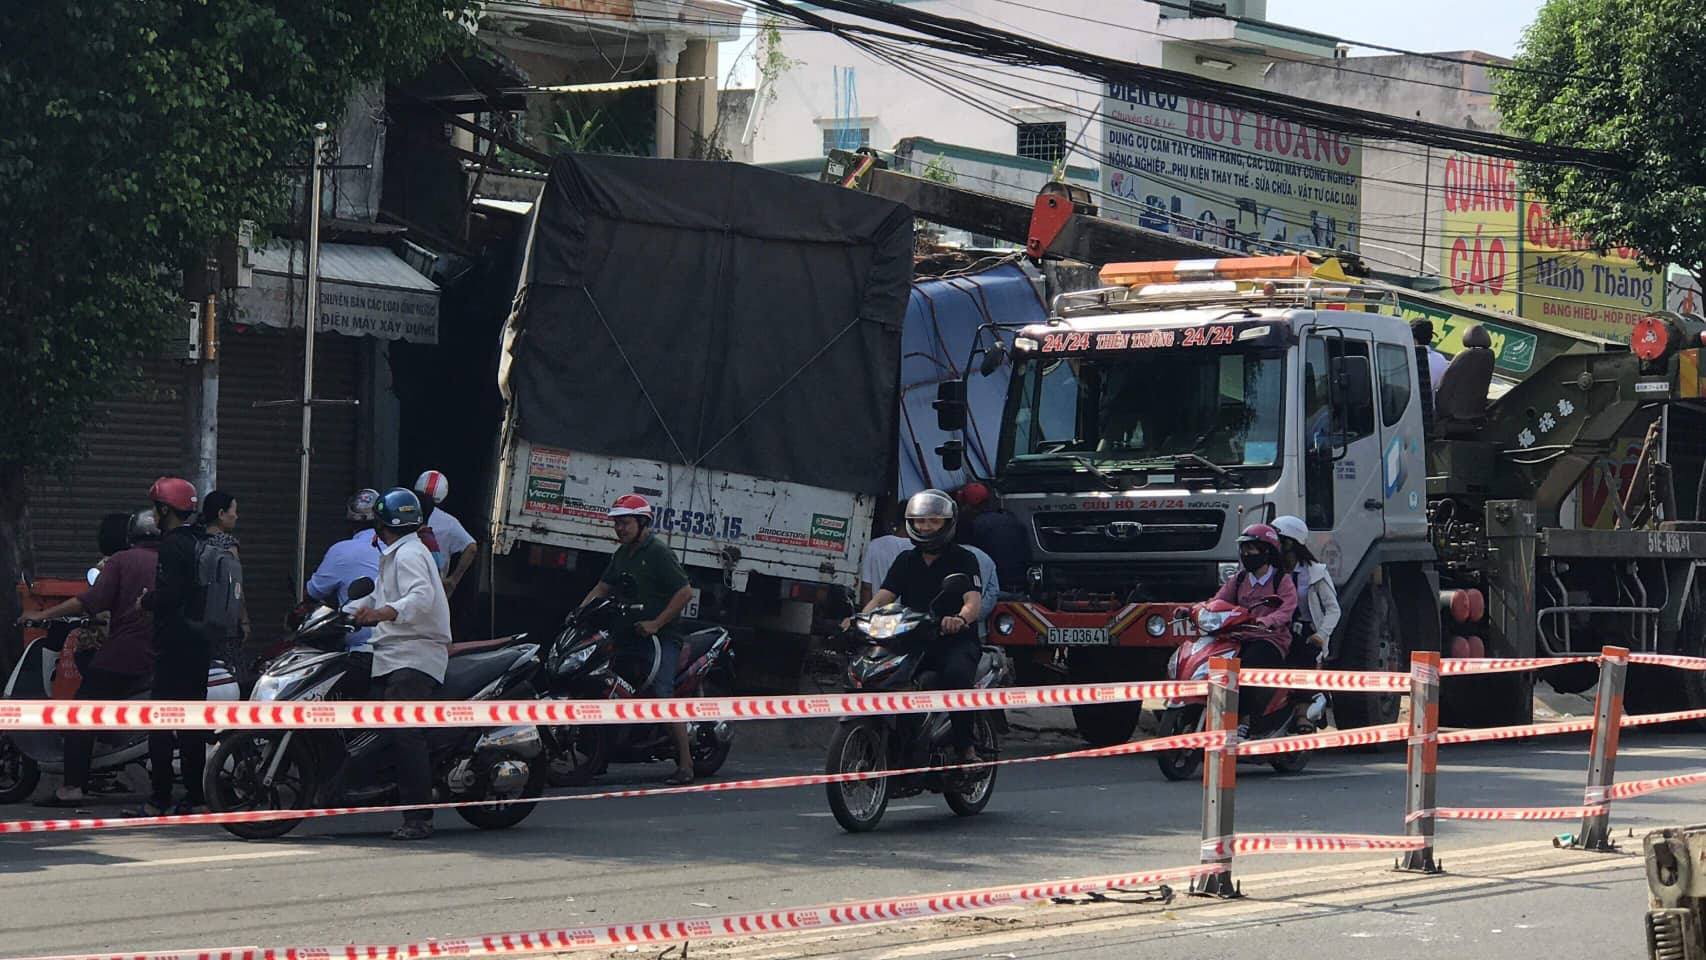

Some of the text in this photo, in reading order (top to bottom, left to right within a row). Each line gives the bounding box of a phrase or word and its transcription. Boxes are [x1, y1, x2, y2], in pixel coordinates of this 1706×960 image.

[1186, 97, 1244, 146] HUY
[1172, 141, 1188, 156] TAY
[1212, 169, 1232, 185] THAY
[1450, 224, 1505, 296] CÁO
[1536, 256, 1585, 292] Minh
[1042, 333, 1090, 352] 24/24
[1182, 326, 1234, 347] 24/24
[1140, 499, 1184, 509] 24/24
